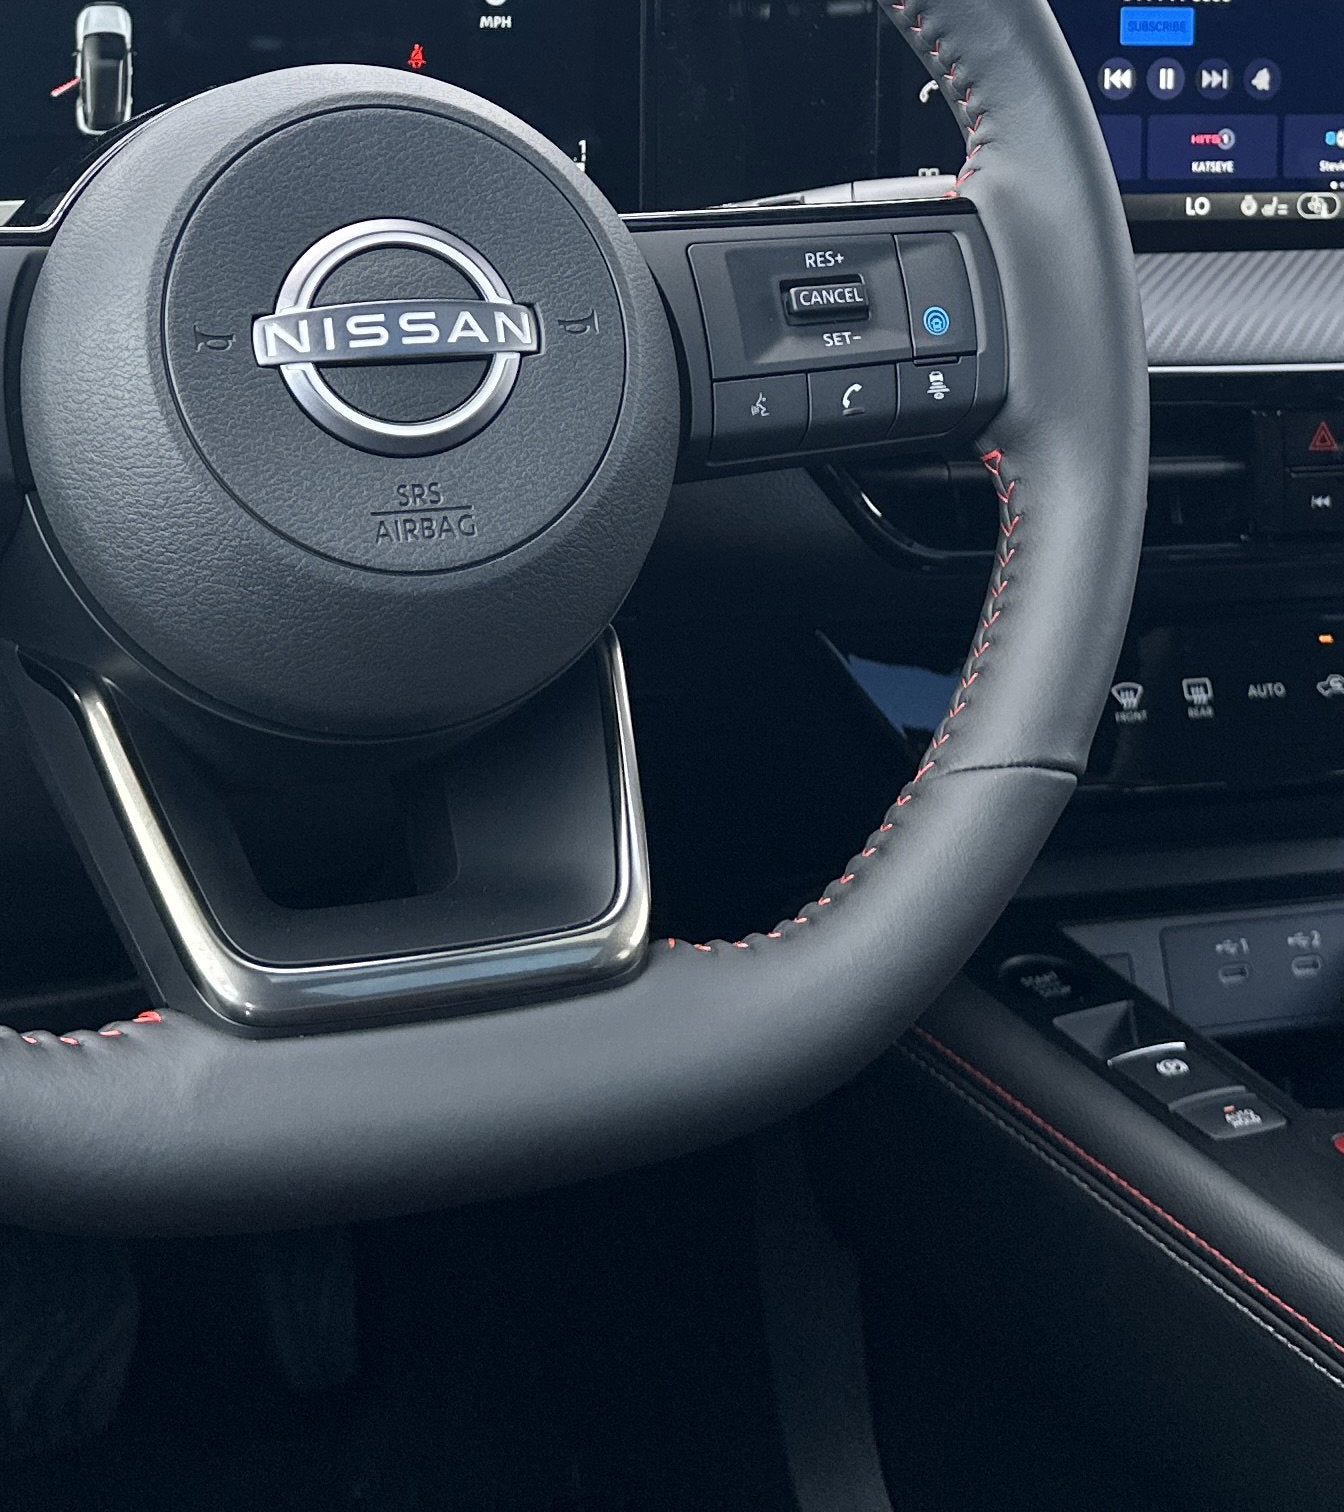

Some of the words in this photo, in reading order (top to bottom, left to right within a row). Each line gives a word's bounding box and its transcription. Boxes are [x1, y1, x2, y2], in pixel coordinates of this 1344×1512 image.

[479, 15, 513, 29] MPH
[1127, 20, 1188, 33] SUBSCRIBE
[1185, 196, 1212, 217] LO
[804, 251, 845, 269] RES+
[799, 289, 864, 306] CANCEL
[264, 310, 534, 358] NISSAN
[395, 482, 444, 506] SRS
[375, 514, 478, 545] AIRBAG
[1248, 682, 1286, 699] AUTO
[1115, 709, 1148, 724] FRONT
[1187, 705, 1215, 719] REAR
